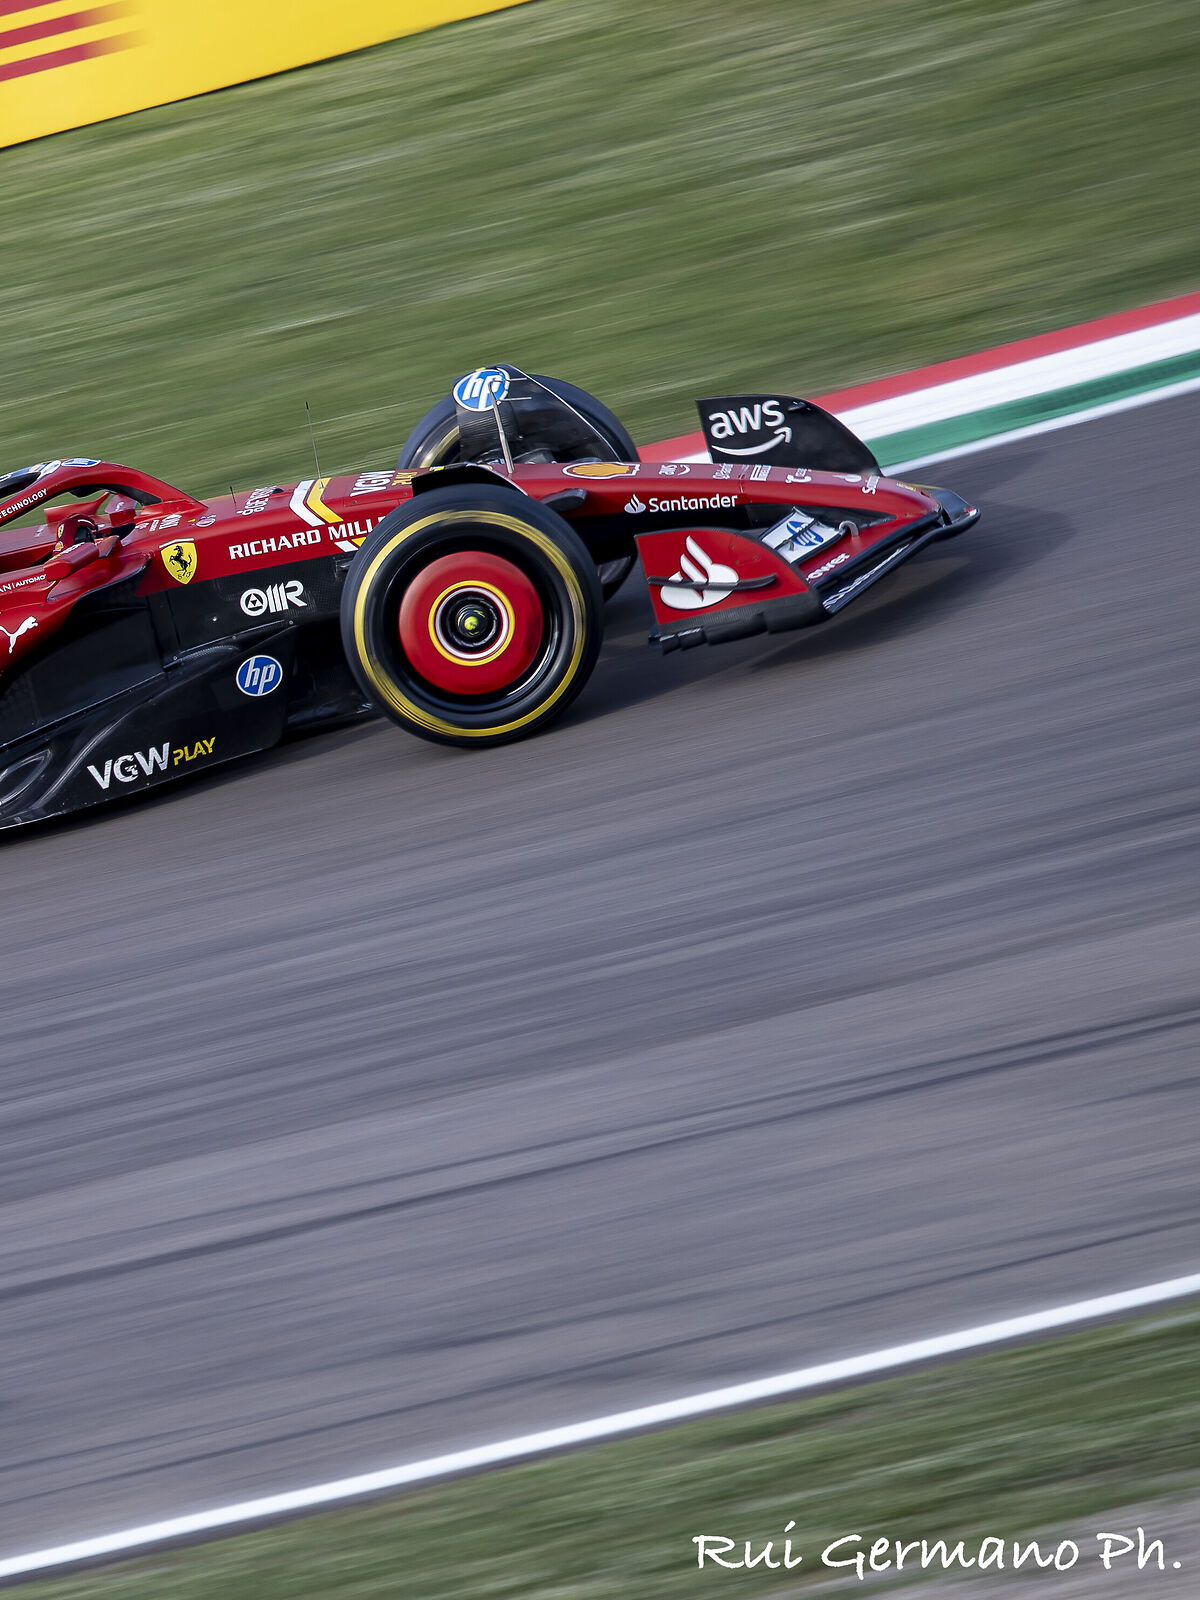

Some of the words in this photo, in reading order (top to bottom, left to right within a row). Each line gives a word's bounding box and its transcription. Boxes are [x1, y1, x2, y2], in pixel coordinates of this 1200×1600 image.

[708, 399, 785, 440] aws
[350, 470, 396, 497] VGW
[649, 493, 738, 513] Santander
[228, 528, 322, 560] RICHARD
[327, 515, 387, 541] MILL
[15, 573, 47, 587] AUTOMO
[243, 655, 275, 695] hp
[87, 742, 170, 789] VGW
[172, 736, 216, 766] PLAY
